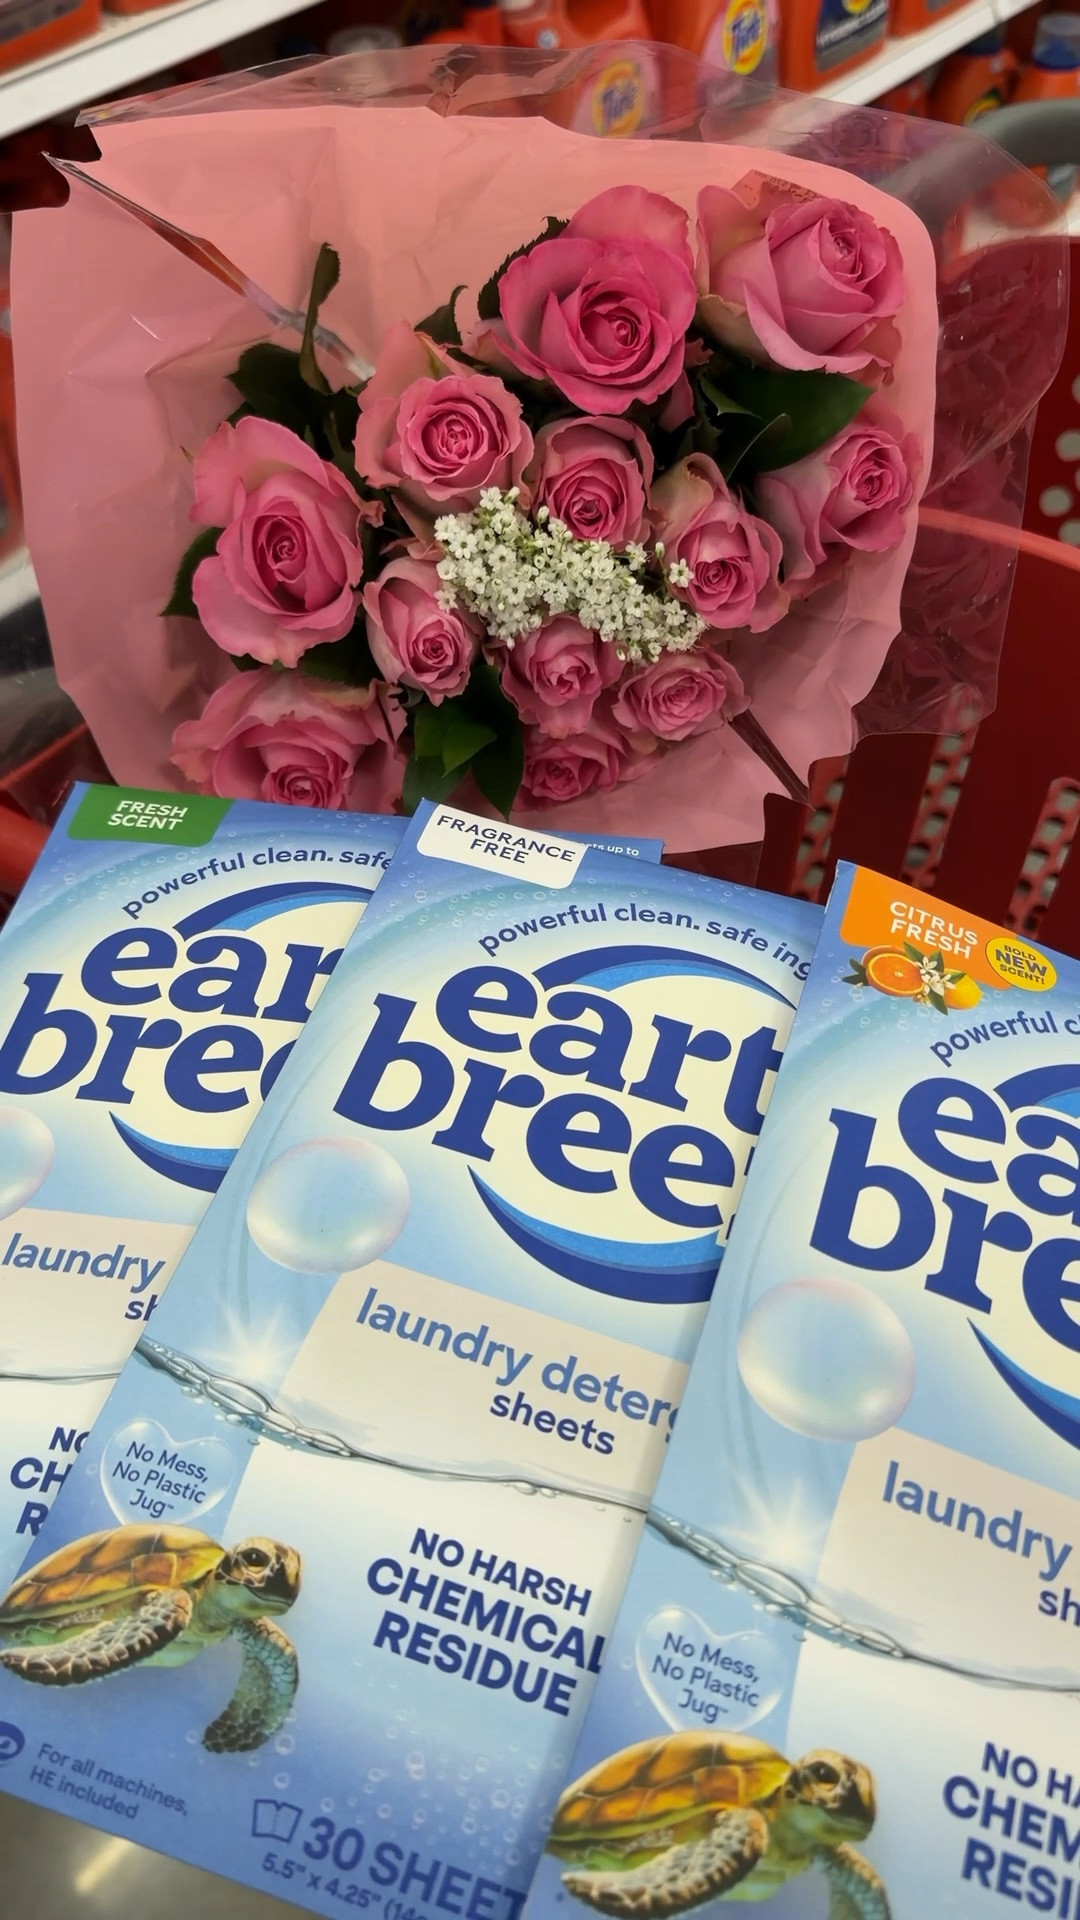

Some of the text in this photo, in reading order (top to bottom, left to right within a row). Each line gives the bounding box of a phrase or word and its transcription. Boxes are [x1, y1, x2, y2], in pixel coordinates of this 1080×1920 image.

[108, 813, 183, 830] SCENT
[117, 801, 188, 817] FRESH
[436, 815, 576, 862] FRAGRANCE
[470, 838, 529, 865] FREE
[607, 845, 623, 854] up
[626, 847, 640, 857] to
[122, 852, 245, 920] powerful
[252, 847, 334, 866] clean.
[477, 904, 607, 957] powerful
[614, 904, 700, 930] clean.
[705, 918, 768, 952] safe
[889, 901, 979, 946] CITRUS
[890, 919, 972, 960] FRESH
[81, 927, 345, 1023] ear
[995, 949, 1047, 977] NEW
[1000, 964, 1045, 985] SCENT!
[1004, 945, 1036, 961] BOLD
[0, 973, 298, 1113] bre
[930, 1010, 1058, 1067] powerful
[333, 993, 756, 1240] bree
[2, 1233, 166, 1293] laundry
[355, 1287, 679, 1443] laundry deter
[489, 1392, 615, 1455] sheets
[112, 1460, 206, 1504] No Plastic
[126, 1441, 208, 1483] No Mess,
[882, 1461, 1072, 1581] laundry
[409, 1528, 592, 1616] NO HARSH
[366, 1557, 607, 1674] CHEMICAL
[372, 1611, 577, 1717] RESIDUE
[652, 1655, 760, 1707] No Plastic
[663, 1632, 759, 1683] No Mess,
[37, 1743, 189, 1816] For all machines,
[982, 1741, 1038, 1788] NO
[30, 1766, 140, 1820] HE included
[943, 1775, 1080, 1863] CHEM
[302, 1817, 365, 1871] 30
[262, 1852, 306, 1880] 5.5"
[307, 1873, 322, 1890] x
[324, 1878, 382, 1909] 4.25"
